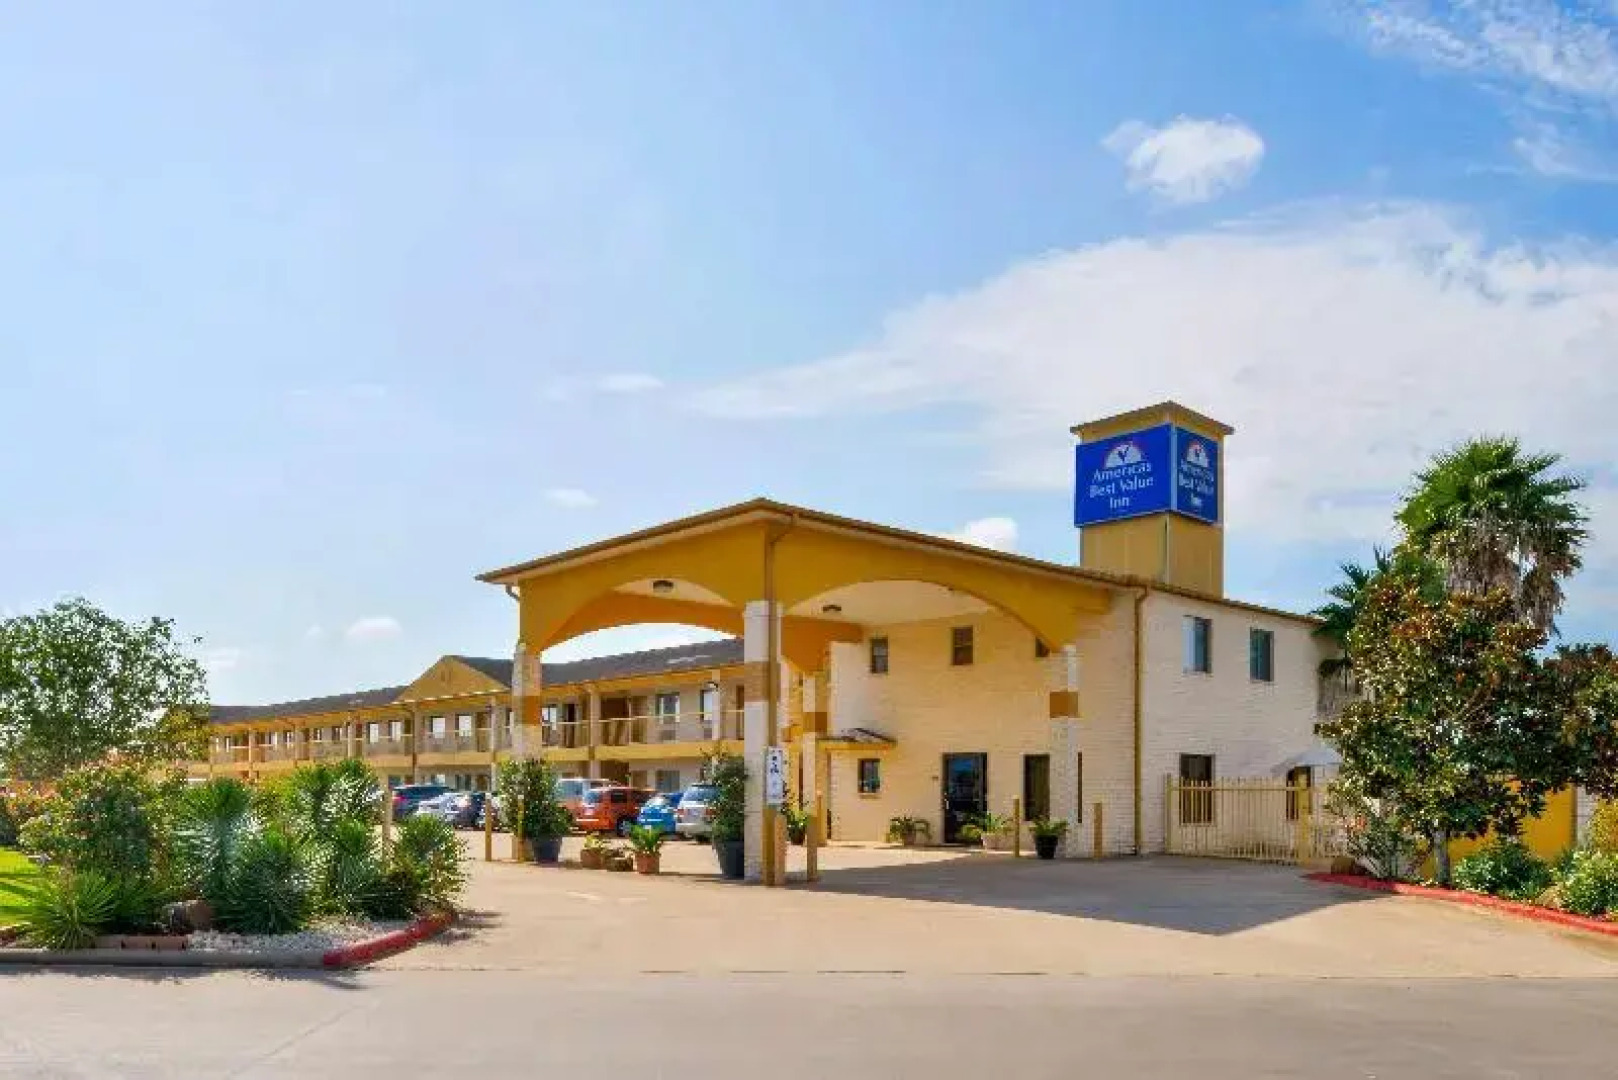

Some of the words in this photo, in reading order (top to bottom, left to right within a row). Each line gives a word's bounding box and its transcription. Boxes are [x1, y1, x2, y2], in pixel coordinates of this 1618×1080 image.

[1091, 463, 1152, 482] Americas
[1089, 482, 1115, 498] Best
[1120, 475, 1154, 492] Value
[1109, 497, 1130, 508] Inn
